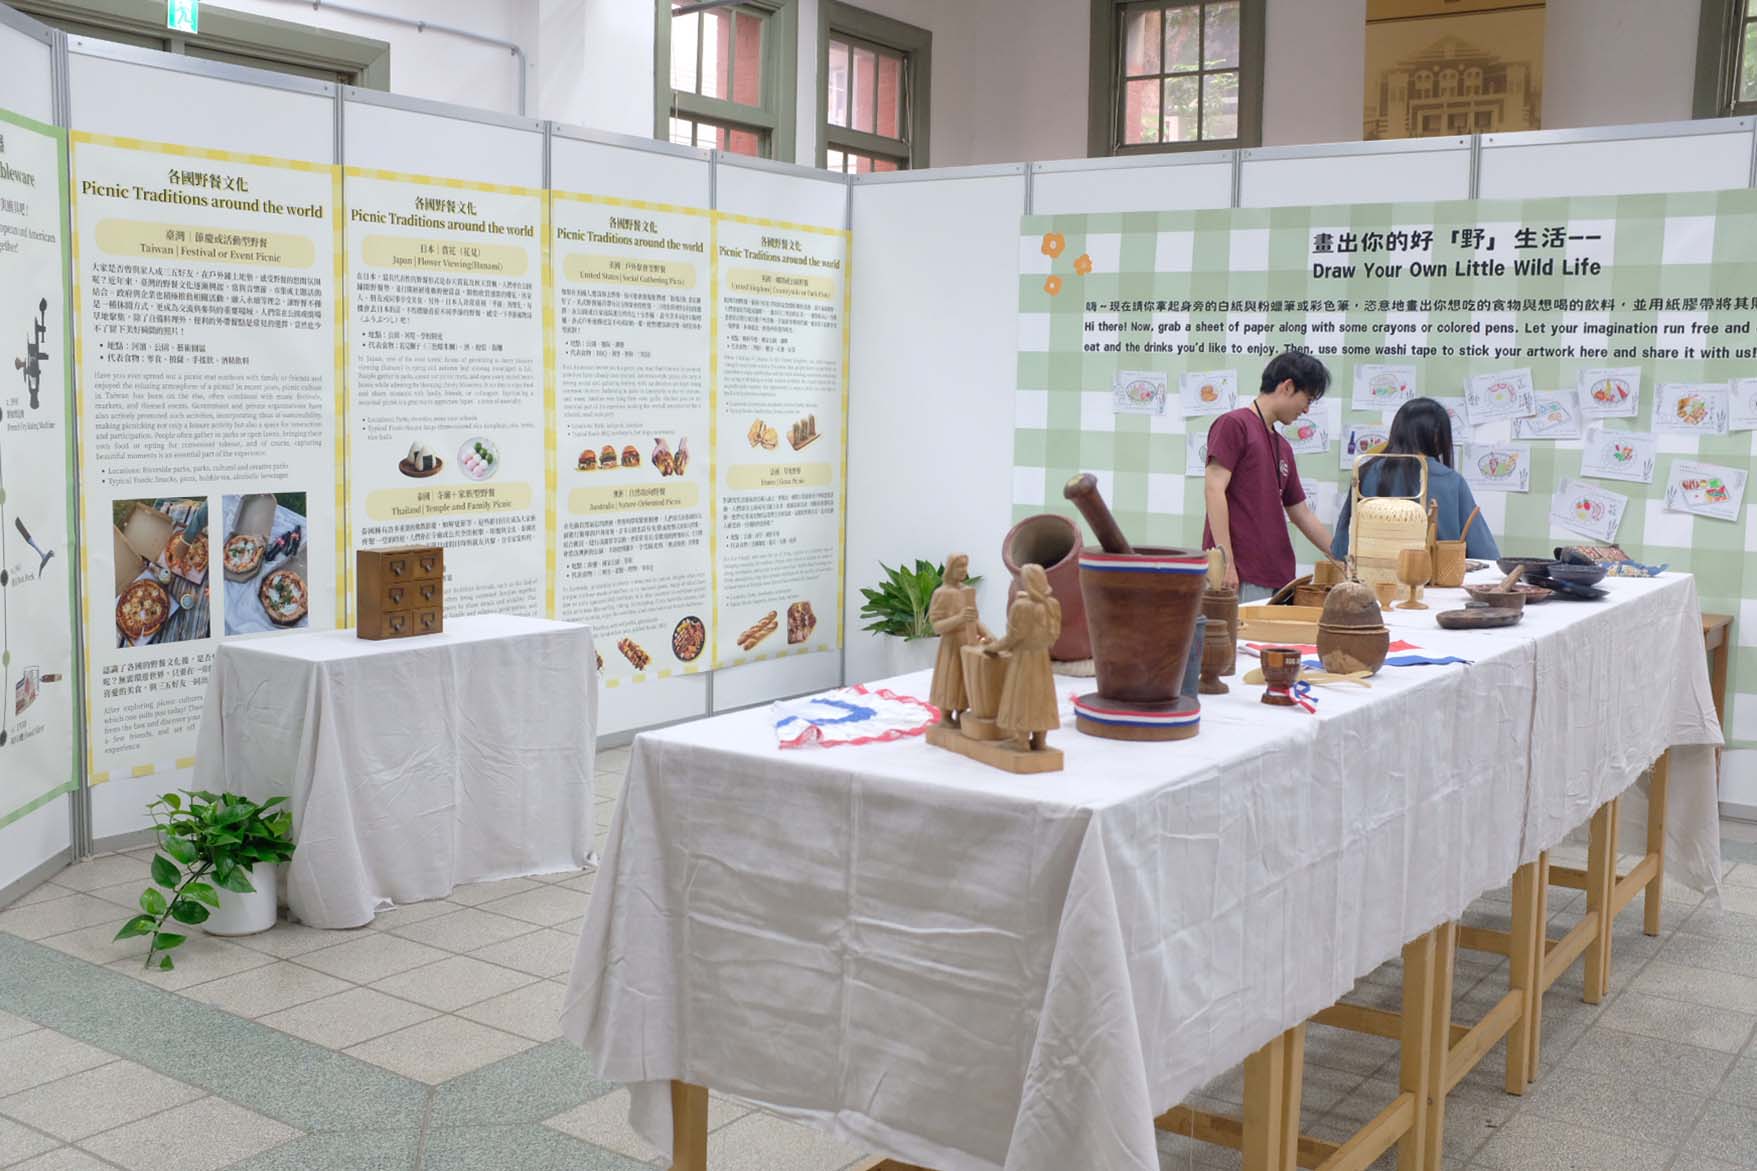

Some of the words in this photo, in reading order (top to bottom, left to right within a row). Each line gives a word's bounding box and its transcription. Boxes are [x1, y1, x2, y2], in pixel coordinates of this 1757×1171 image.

[168, 168, 248, 192] 各國野餐文化
[82, 180, 129, 199] Picnic
[132, 185, 208, 208] Traditions
[211, 196, 259, 212] around
[262, 199, 284, 214] the
[286, 205, 324, 218] world
[415, 196, 478, 216] 各國野餐文化
[351, 209, 386, 224] Picnic
[388, 212, 446, 228] Traditions
[448, 220, 486, 234] around
[488, 221, 504, 234] the
[506, 226, 534, 238] world
[610, 216, 658, 234] 各國野餐文化
[557, 228, 586, 242] Picnic
[587, 230, 633, 246] Traditions
[634, 236, 666, 250] around
[667, 238, 681, 250] the
[682, 242, 704, 254] world
[140, 243, 174, 256] Taiwan
[180, 246, 216, 258] Festival
[218, 250, 228, 258] or
[230, 248, 254, 261] Event
[256, 252, 281, 262] Picnic
[392, 256, 413, 266] Japan
[418, 257, 441, 268] Flower
[719, 246, 743, 258] Picnic
[744, 249, 781, 262] Traditions
[782, 254, 808, 266] around
[809, 254, 821, 267] the
[822, 259, 840, 270] world
[1312, 262, 1356, 280] Draw
[1363, 262, 1402, 279] Your
[1409, 261, 1448, 278] Own
[1455, 258, 1506, 278] Little
[1514, 258, 1554, 277] Wild
[1562, 257, 1602, 276] Life
[1084, 322, 1094, 332] Hi
[1098, 321, 1128, 332] there!
[1131, 322, 1154, 333] Now,
[1158, 322, 1181, 334] grab
[1196, 322, 1224, 332] sheet
[1228, 322, 1239, 332] of
[1244, 324, 1274, 335] paper
[1279, 322, 1308, 335] along
[1312, 322, 1334, 333] with
[1339, 324, 1368, 333] some
[1372, 324, 1416, 336] crayons
[1421, 324, 1432, 333] or
[1437, 322, 1480, 334] colored
[1485, 324, 1518, 336] pens.
[1525, 322, 1546, 334] Let
[1551, 324, 1578, 336] your
[1583, 322, 1658, 336] imagination
[1664, 324, 1685, 334] run
[1690, 322, 1719, 334] free
[1724, 322, 1750, 334] and
[1084, 342, 1100, 352] eat
[1104, 342, 1121, 352] and
[1126, 342, 1140, 352] the
[1144, 342, 1173, 352] drinks
[1177, 342, 1205, 356] you'd
[1208, 342, 1227, 353] like
[1232, 344, 1242, 353] to
[1246, 342, 1278, 357] enjoy.
[1284, 343, 1313, 354] Then,
[1318, 346, 1338, 354] use
[1342, 346, 1370, 355] some
[1375, 344, 1406, 355] washi
[1411, 346, 1437, 358] tape
[1442, 346, 1454, 356] to
[1458, 344, 1489, 356] stick
[1494, 346, 1523, 360] your
[1526, 345, 1574, 358] artwork
[1580, 346, 1608, 358] here
[1613, 346, 1636, 358] and
[1642, 346, 1679, 358] share
[1684, 346, 1695, 358] it
[1700, 346, 1730, 358] with
[1736, 346, 1757, 358] us!
[392, 506, 421, 515] Thailand
[452, 502, 466, 510] and
